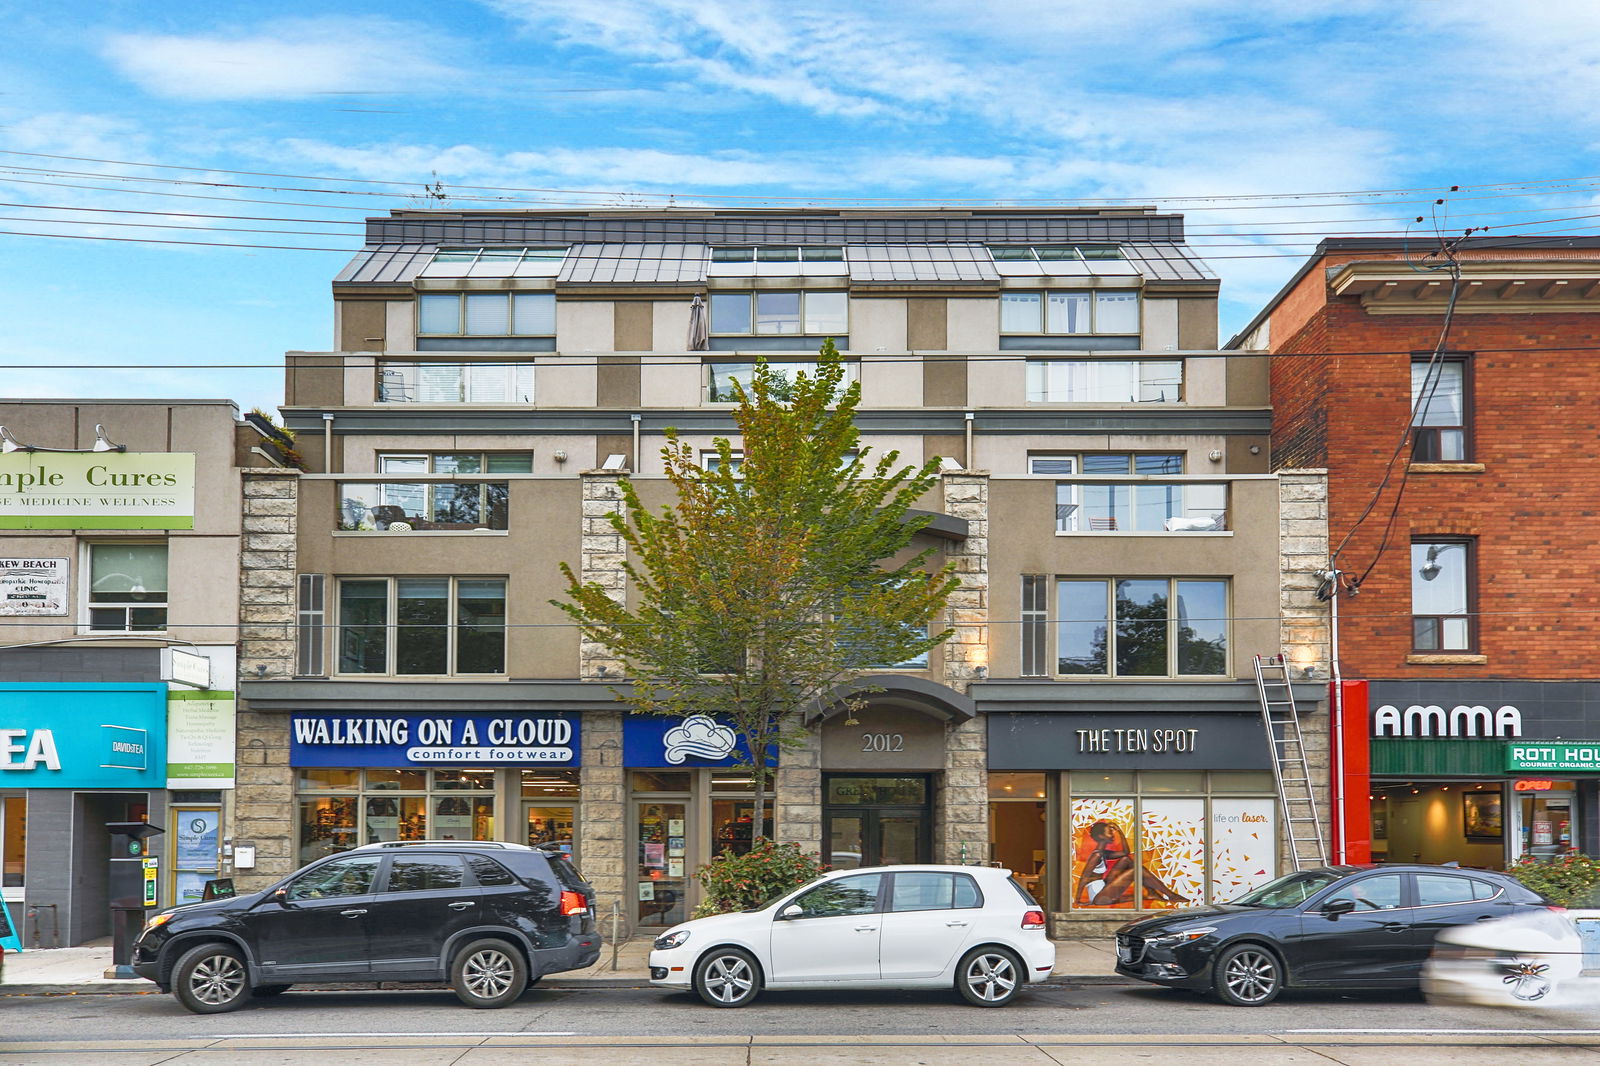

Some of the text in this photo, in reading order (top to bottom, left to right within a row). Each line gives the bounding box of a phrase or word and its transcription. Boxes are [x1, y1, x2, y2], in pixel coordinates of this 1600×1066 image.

[86, 466, 177, 487] Cures
[20, 498, 92, 506] MEDICINE
[100, 498, 176, 506] WELLNESS
[0, 560, 57, 568] KEW BEACH
[1375, 705, 1522, 737] AMMA
[294, 719, 572, 745] WALKING ON A CLOUD
[862, 734, 904, 752] 2012
[1076, 729, 1199, 752] THE TEN SPOT
[0, 729, 62, 770] EA
[413, 749, 567, 760] comfort footwear
[1513, 748, 1556, 761] ROTI
[1514, 780, 1552, 791] OPEN
[1213, 813, 1227, 823] life
[1228, 815, 1240, 823] on
